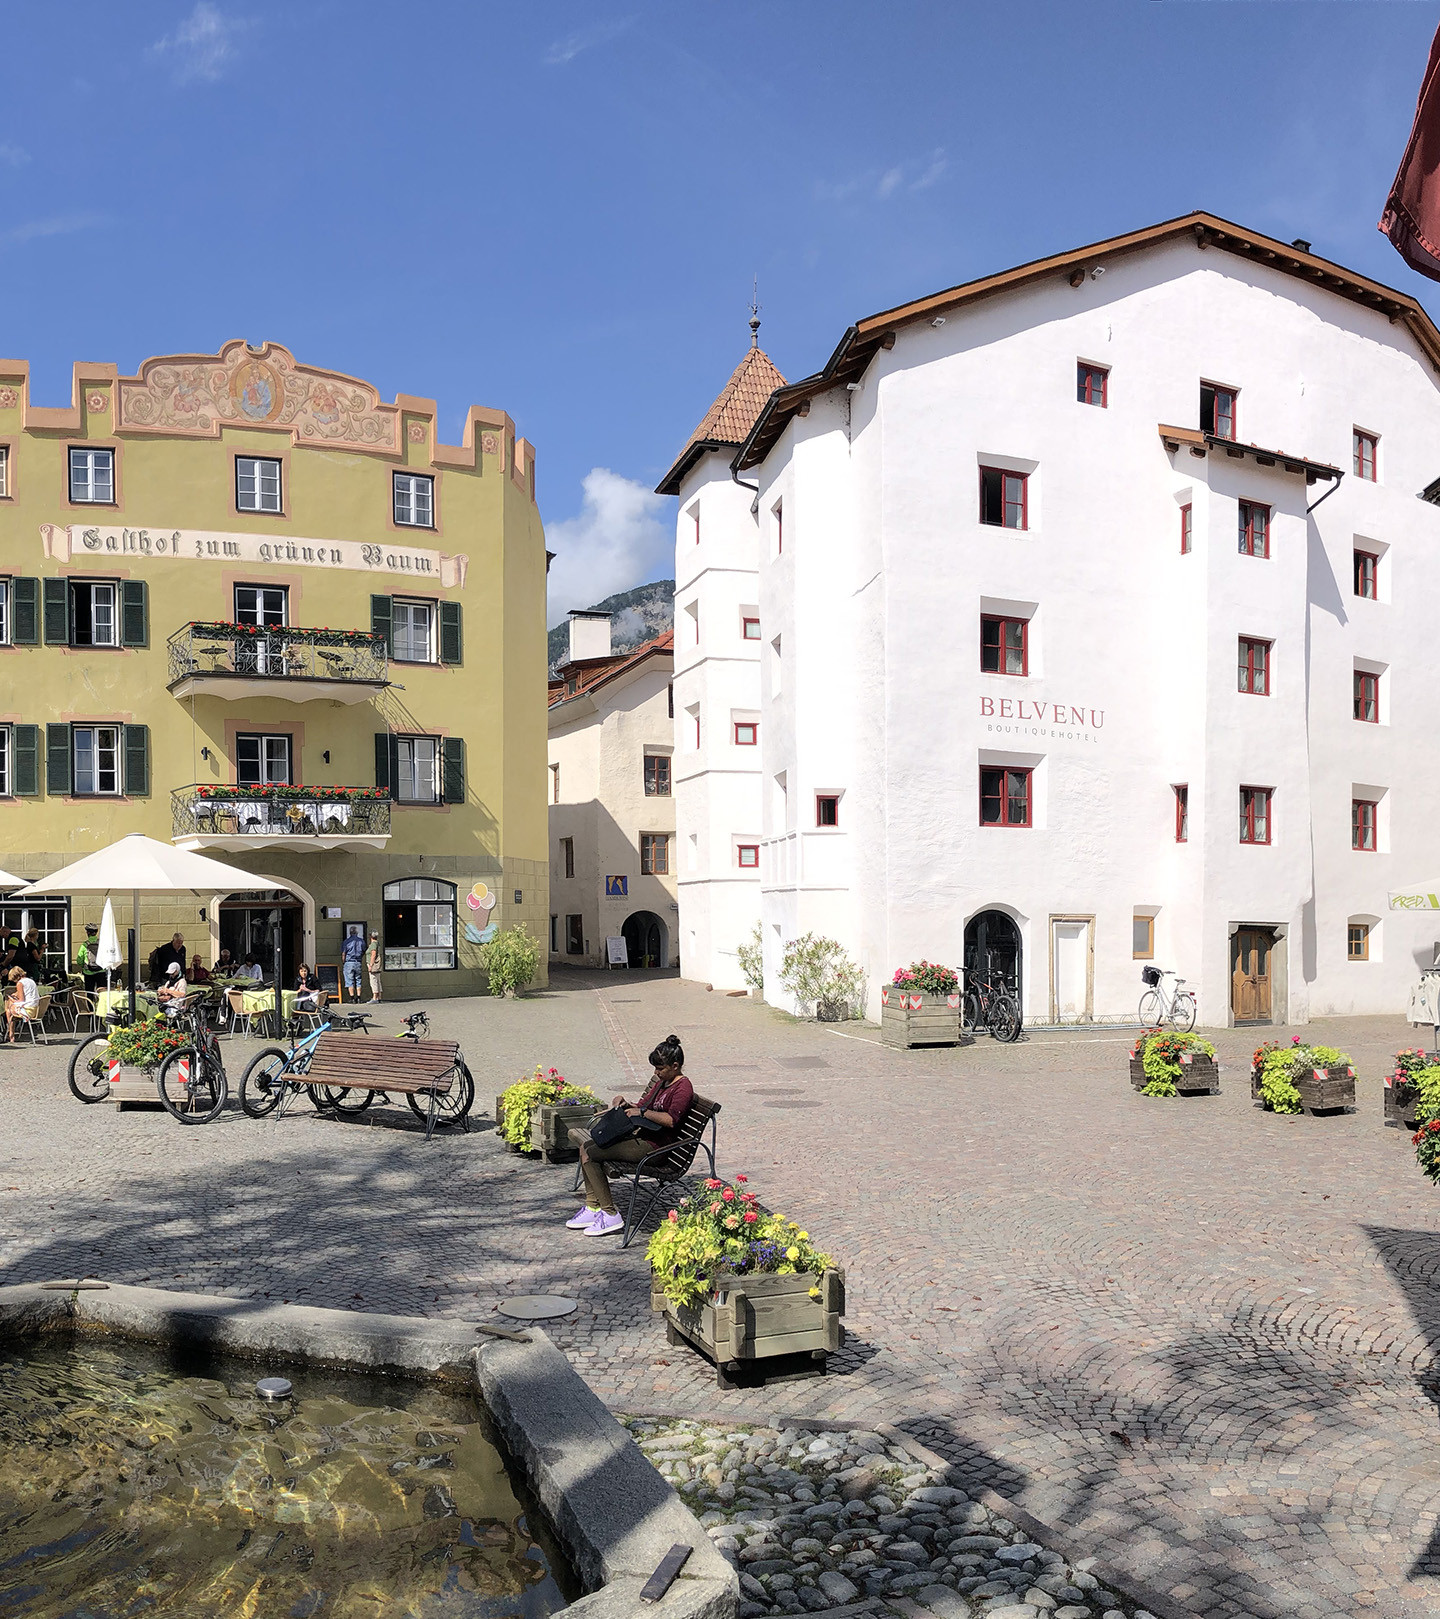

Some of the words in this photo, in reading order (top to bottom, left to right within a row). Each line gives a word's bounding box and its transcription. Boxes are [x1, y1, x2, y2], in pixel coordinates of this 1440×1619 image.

[195, 540, 241, 558] zum
[259, 541, 343, 563] grünen
[979, 696, 1105, 729] BELVENU
